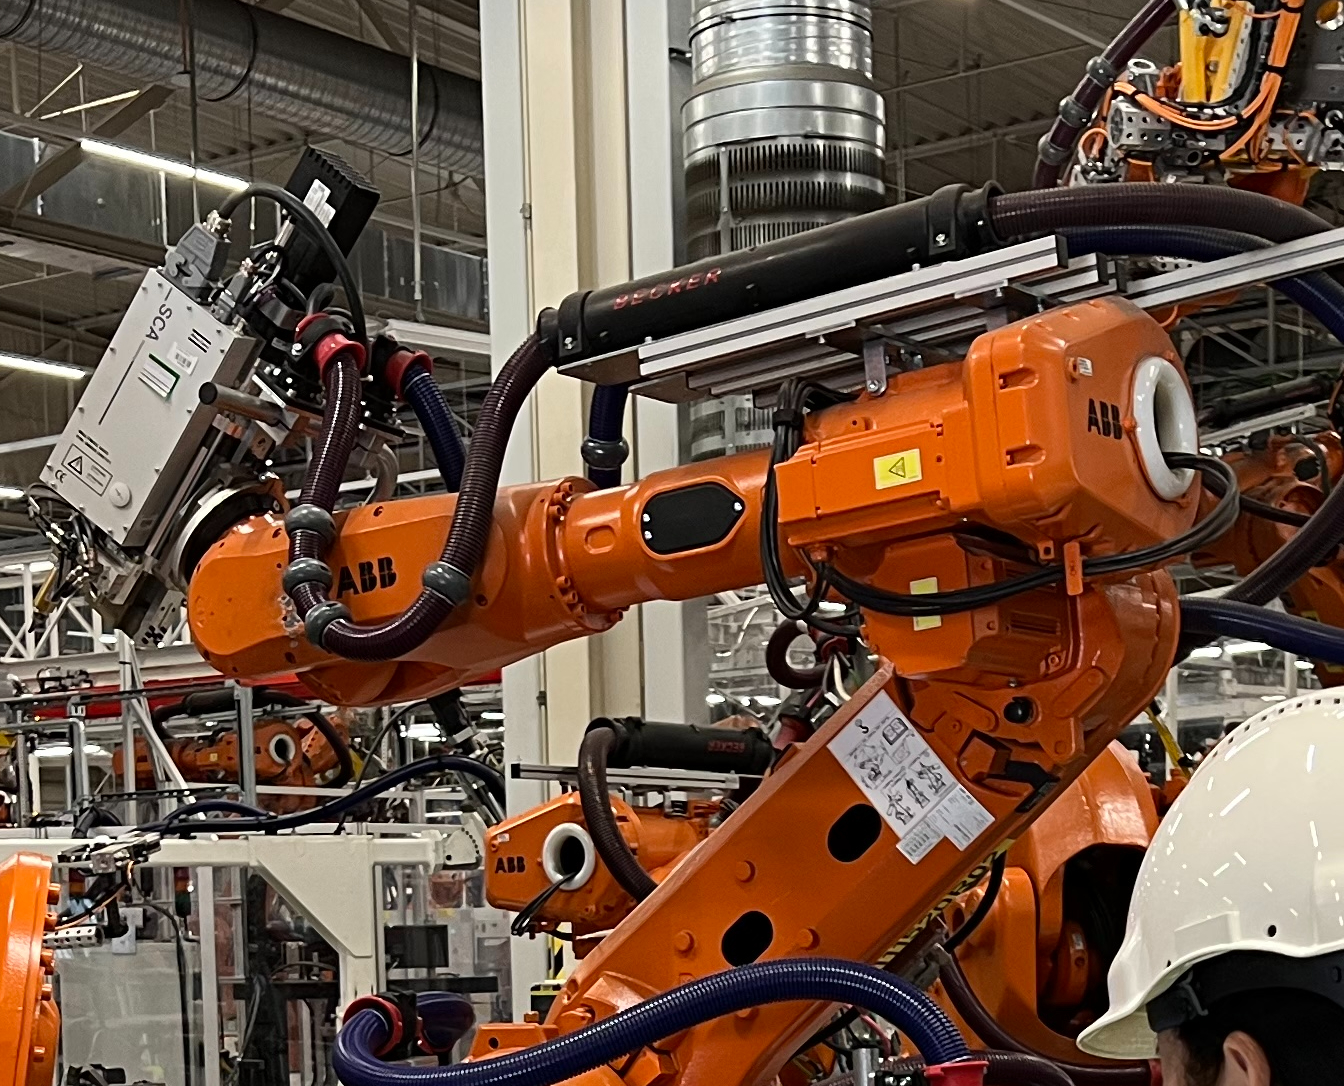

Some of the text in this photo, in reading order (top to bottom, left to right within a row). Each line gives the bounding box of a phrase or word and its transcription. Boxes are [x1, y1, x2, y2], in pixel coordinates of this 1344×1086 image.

[613, 267, 721, 310] BECKER
[145, 303, 173, 341] SCA
[1087, 398, 1122, 440] ABB
[336, 556, 397, 599] ABB
[495, 856, 526, 873] ABB
